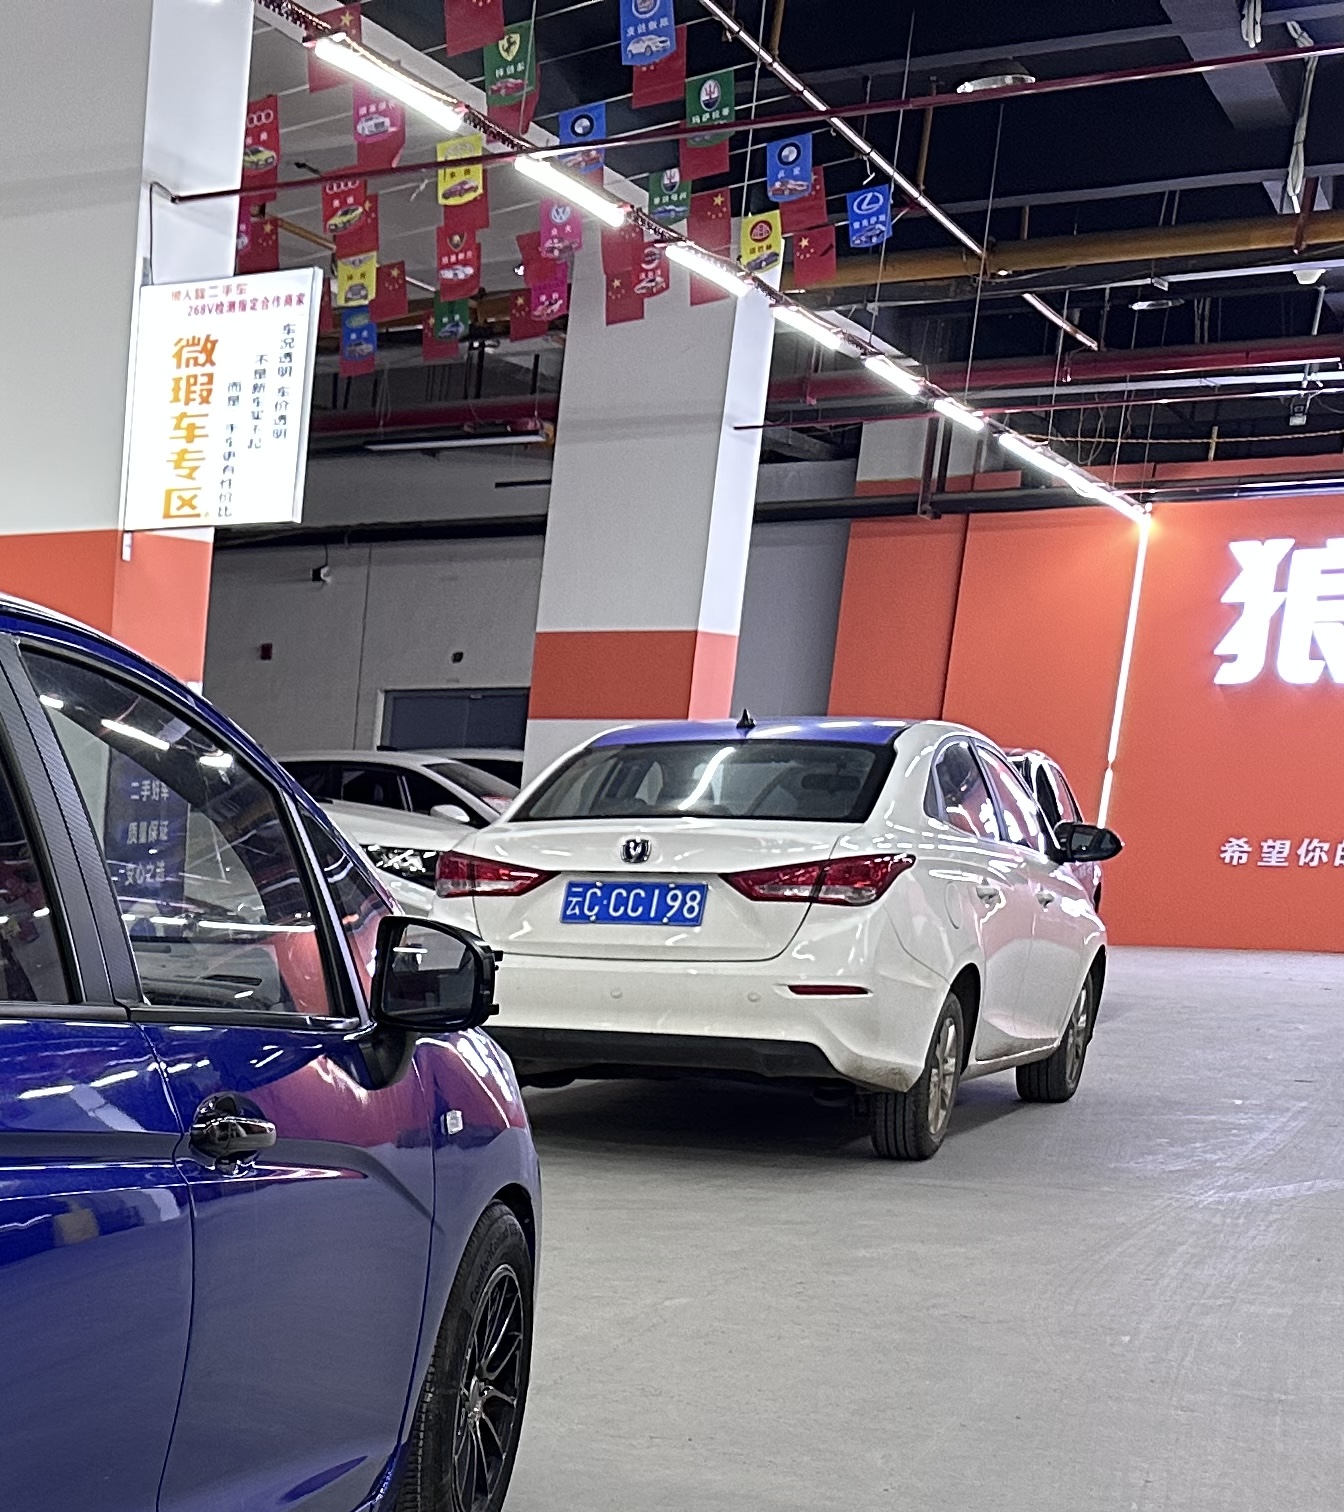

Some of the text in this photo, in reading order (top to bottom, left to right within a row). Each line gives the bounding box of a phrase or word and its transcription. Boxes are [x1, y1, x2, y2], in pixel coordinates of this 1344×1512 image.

[163, 334, 219, 519] 微瑕车专区
